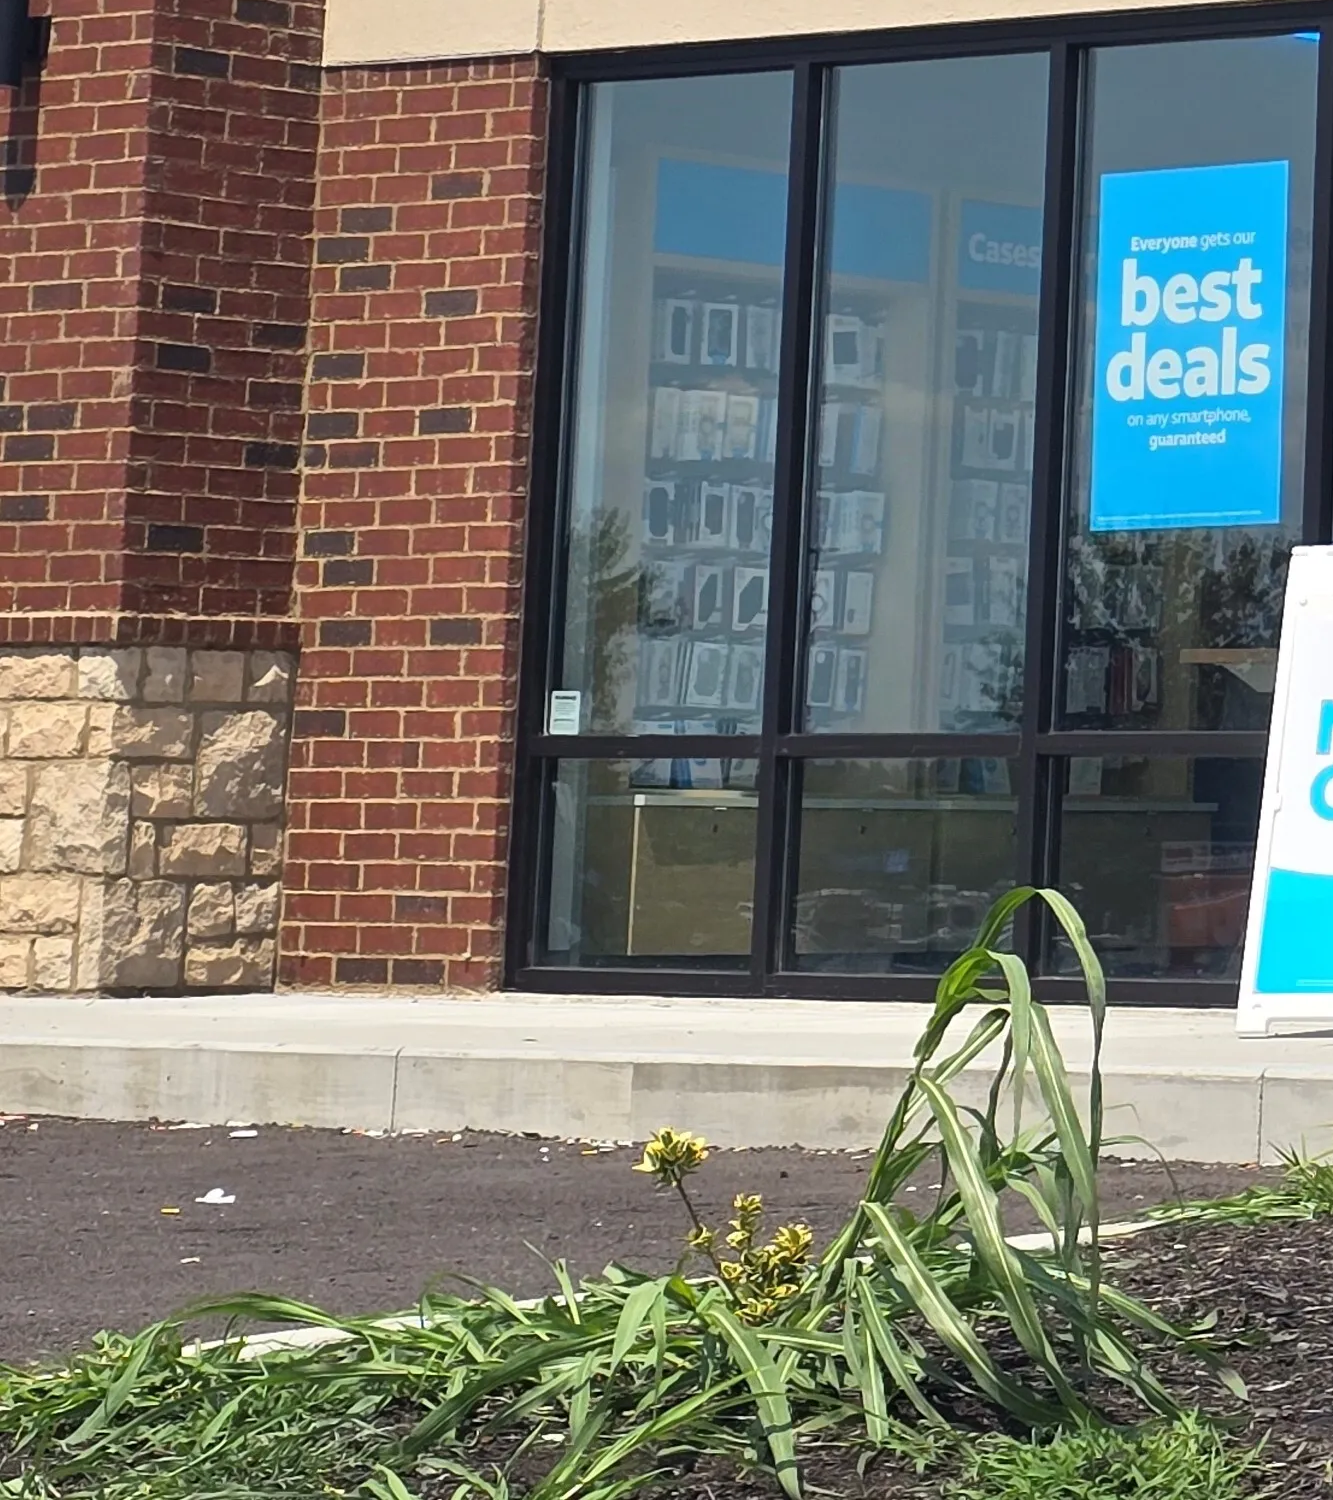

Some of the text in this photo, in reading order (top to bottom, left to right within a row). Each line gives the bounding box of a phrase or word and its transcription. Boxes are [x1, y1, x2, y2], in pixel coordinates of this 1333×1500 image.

[968, 232, 1042, 268] Cases
[1131, 231, 1256, 254] Everyone gets our
[1121, 257, 1262, 326] best
[1106, 327, 1271, 401] deals
[1127, 414, 1143, 427] on
[1146, 412, 1169, 429] any
[1149, 428, 1226, 451] guaranteed
